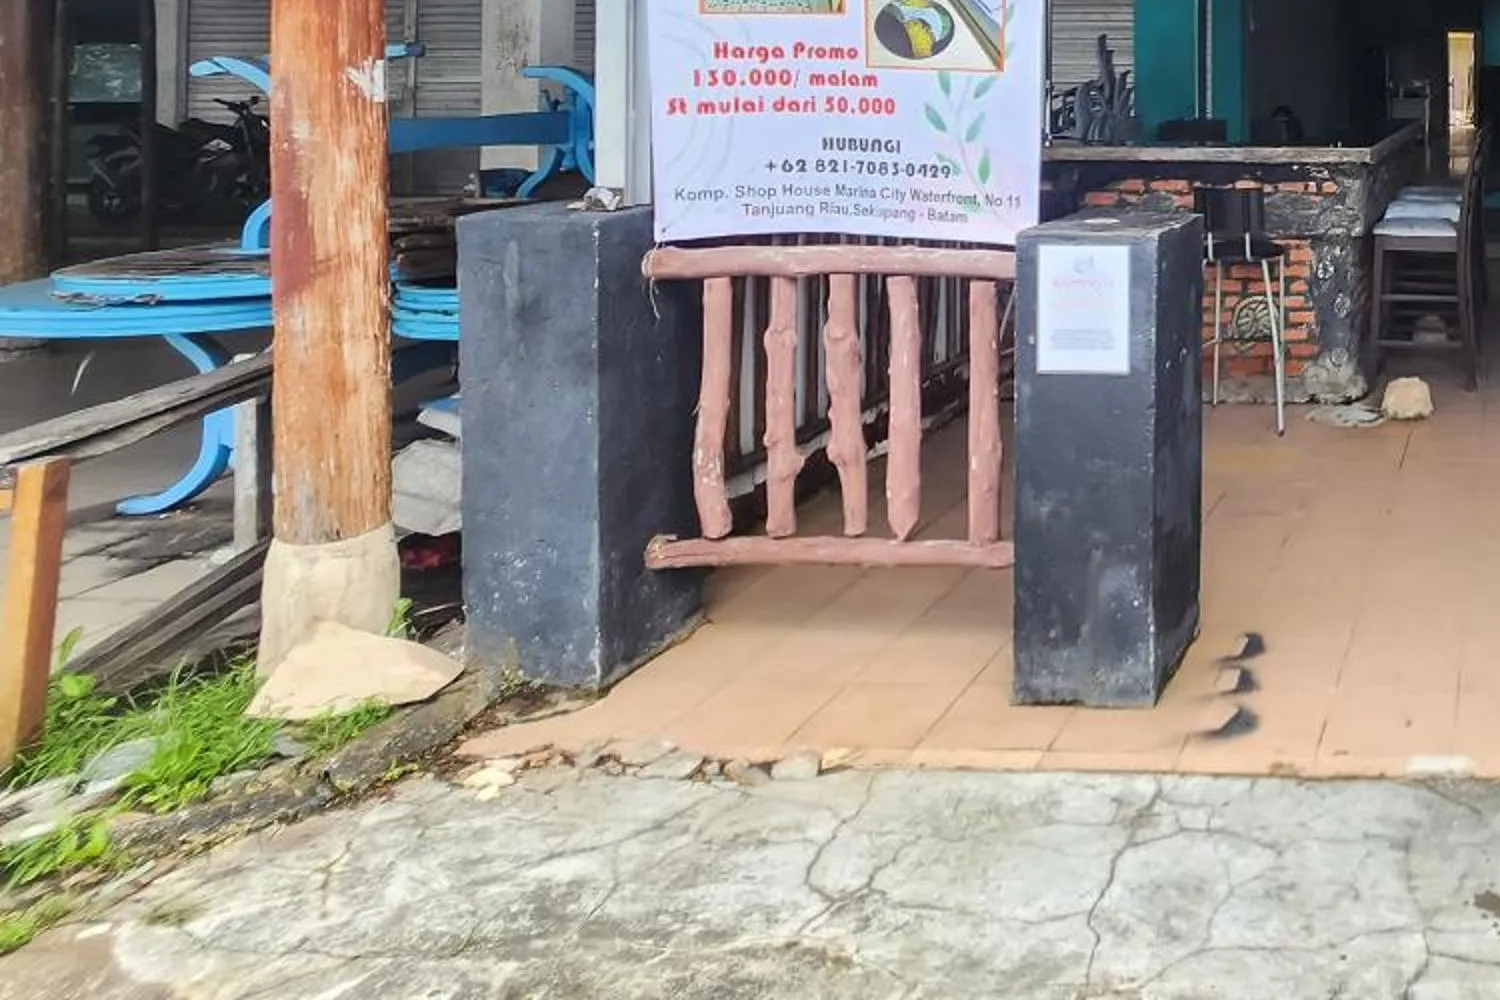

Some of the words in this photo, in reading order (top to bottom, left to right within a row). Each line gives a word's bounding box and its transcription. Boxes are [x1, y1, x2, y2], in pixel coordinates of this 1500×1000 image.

[714, 42, 785, 62] Harga
[793, 42, 859, 59] Promo
[809, 71, 878, 87] malam
[666, 98, 687, 115] St
[697, 97, 764, 114] mulai
[772, 97, 816, 113] dari
[825, 97, 896, 114] 50.000
[765, 160, 807, 173] +62
[674, 189, 729, 201] Komp.
[735, 186, 777, 197] Shop
[782, 184, 831, 197] House
[835, 184, 876, 199] Marina
[880, 188, 906, 202] City
[927, 209, 969, 223] Batam
